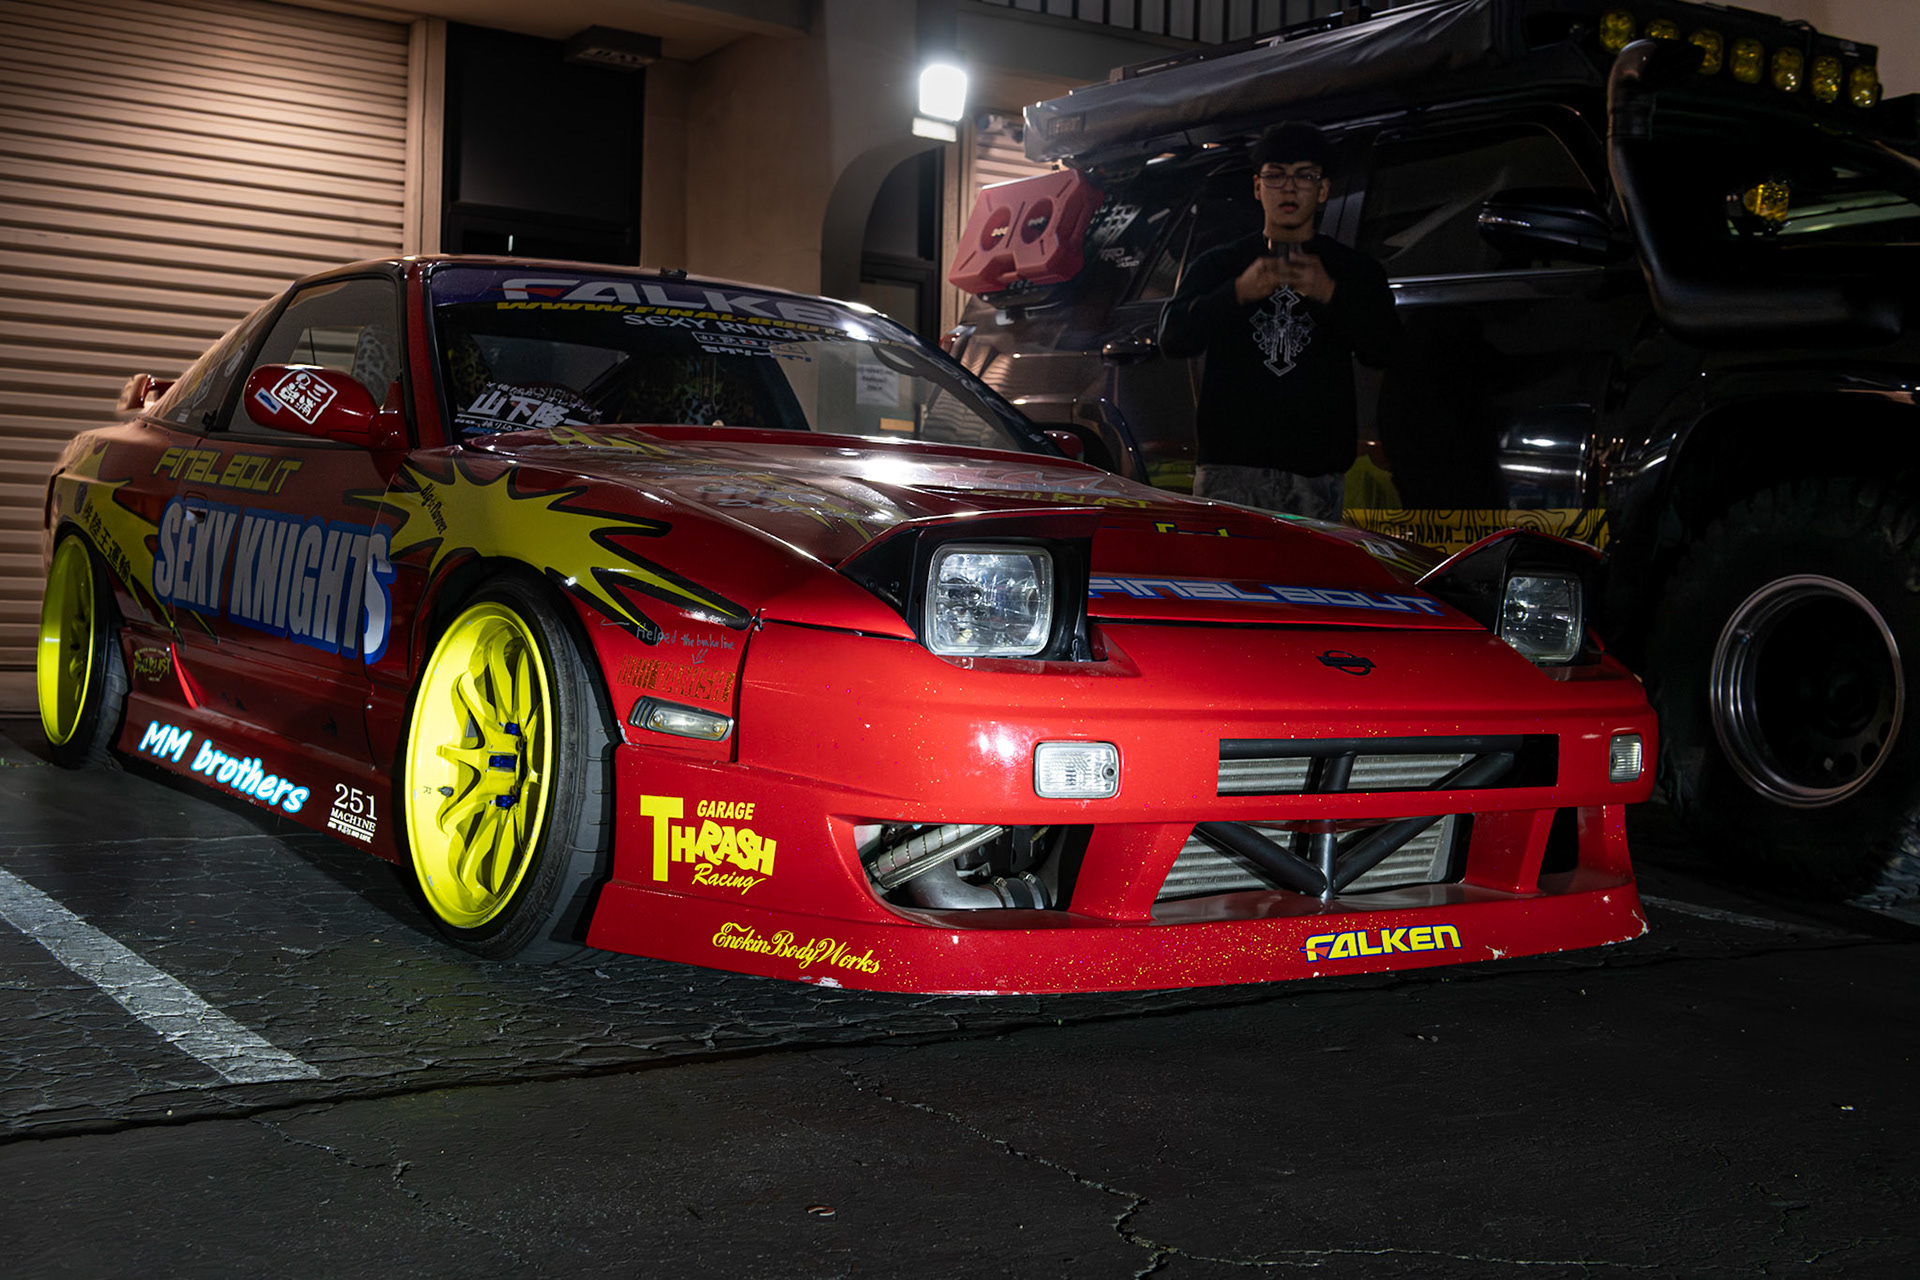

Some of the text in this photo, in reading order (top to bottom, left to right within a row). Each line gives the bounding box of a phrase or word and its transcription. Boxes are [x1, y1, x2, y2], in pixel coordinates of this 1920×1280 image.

[502, 278, 842, 327] FALKE
[622, 314, 709, 332] SEXY
[152, 447, 303, 494] FINAL BOUT
[153, 499, 394, 660] SEXY KNIGHTS
[636, 622, 677, 647] Helped
[680, 634, 694, 647] the
[720, 635, 735, 650] line
[138, 720, 310, 813] MM brothers
[330, 807, 377, 833] MACHINE
[333, 783, 378, 820] 251
[696, 799, 755, 821] GARAGE
[692, 863, 767, 896] Racing
[1303, 923, 1463, 963] FALKEN
